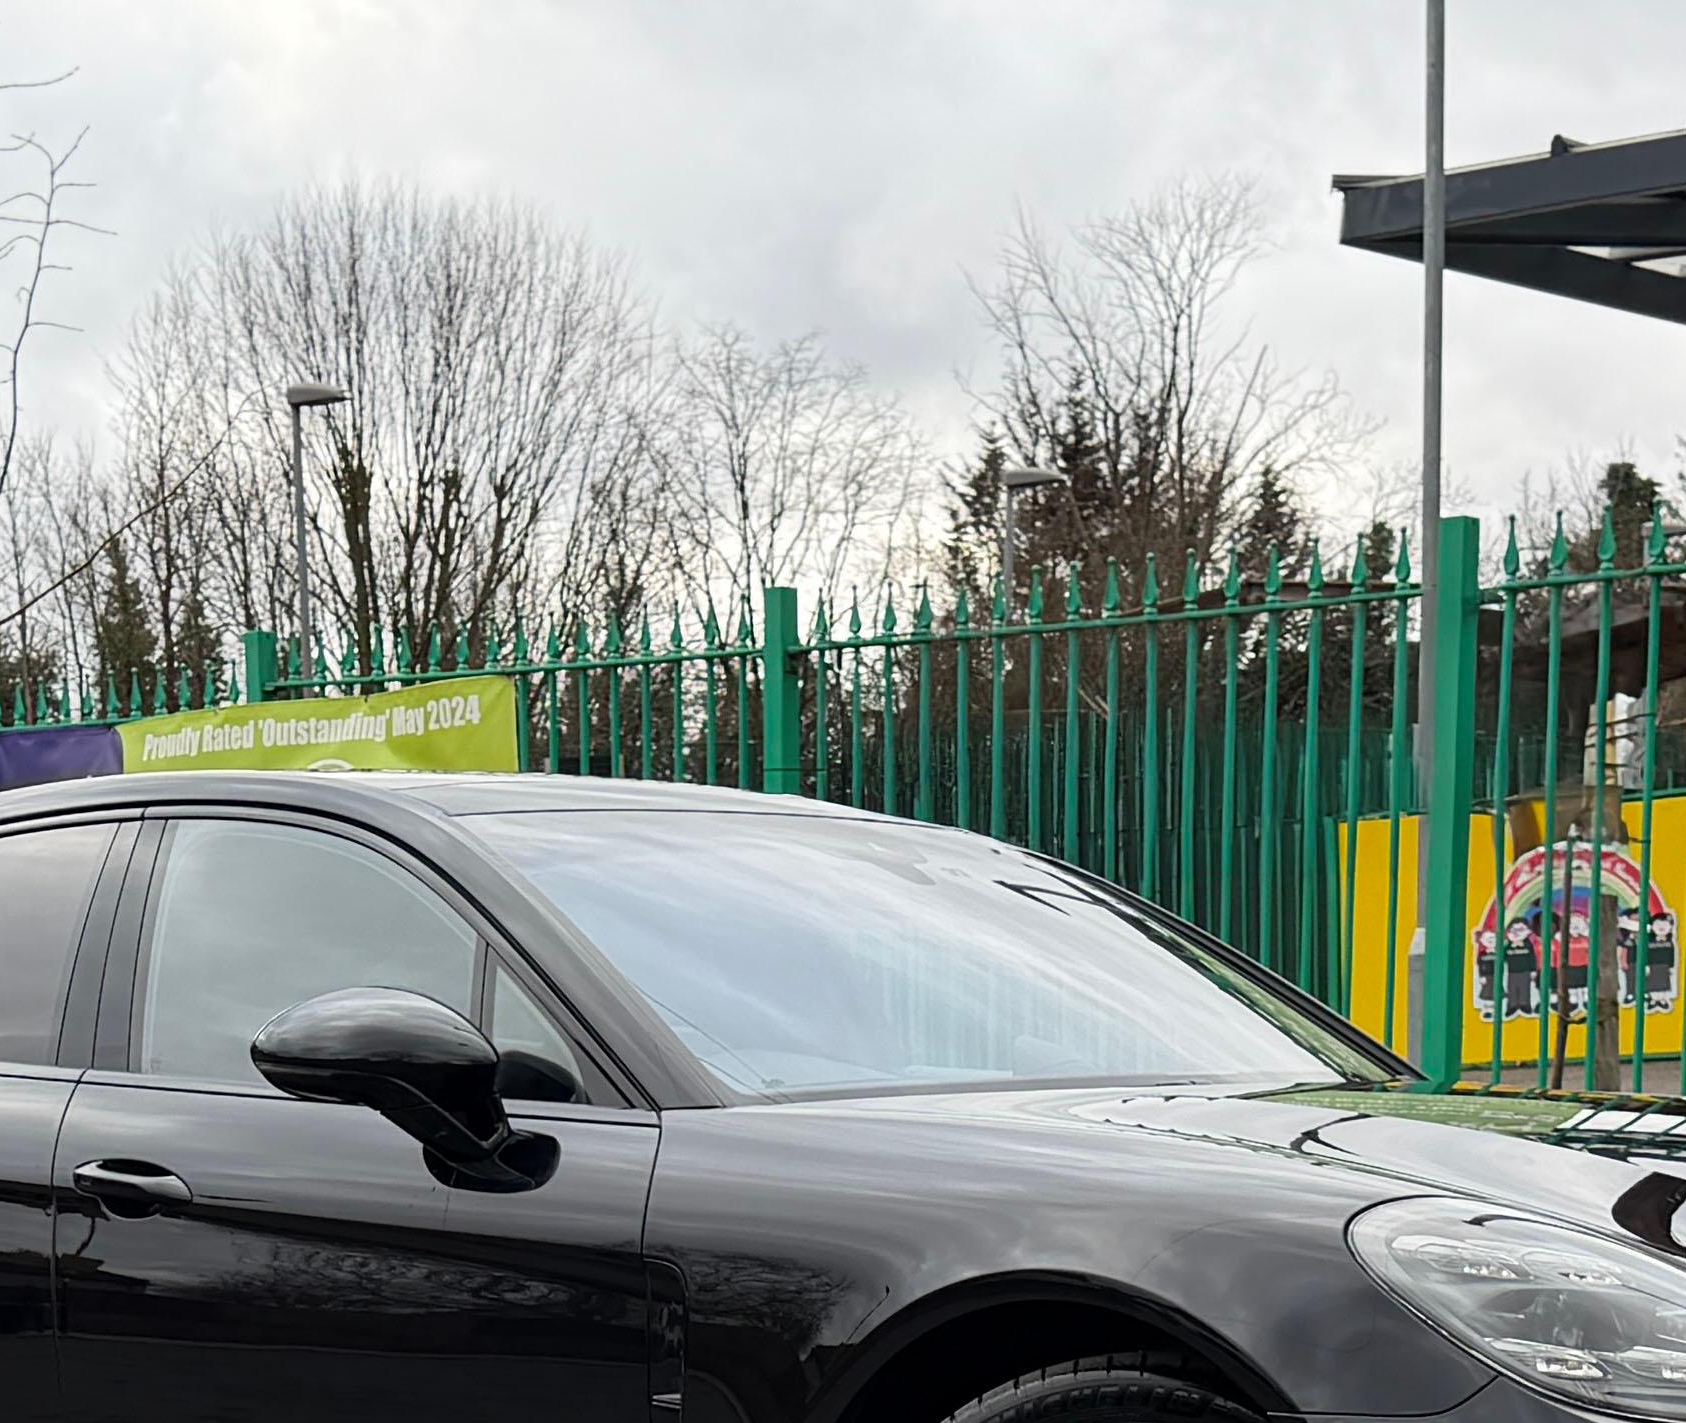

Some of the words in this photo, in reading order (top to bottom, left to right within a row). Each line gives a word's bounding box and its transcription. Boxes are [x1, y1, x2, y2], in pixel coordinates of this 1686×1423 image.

[143, 726, 200, 761] Proudly
[202, 720, 254, 754] Rated
[257, 710, 391, 749] 'Outstanding'
[392, 705, 424, 737] May
[426, 695, 482, 730] 2024
